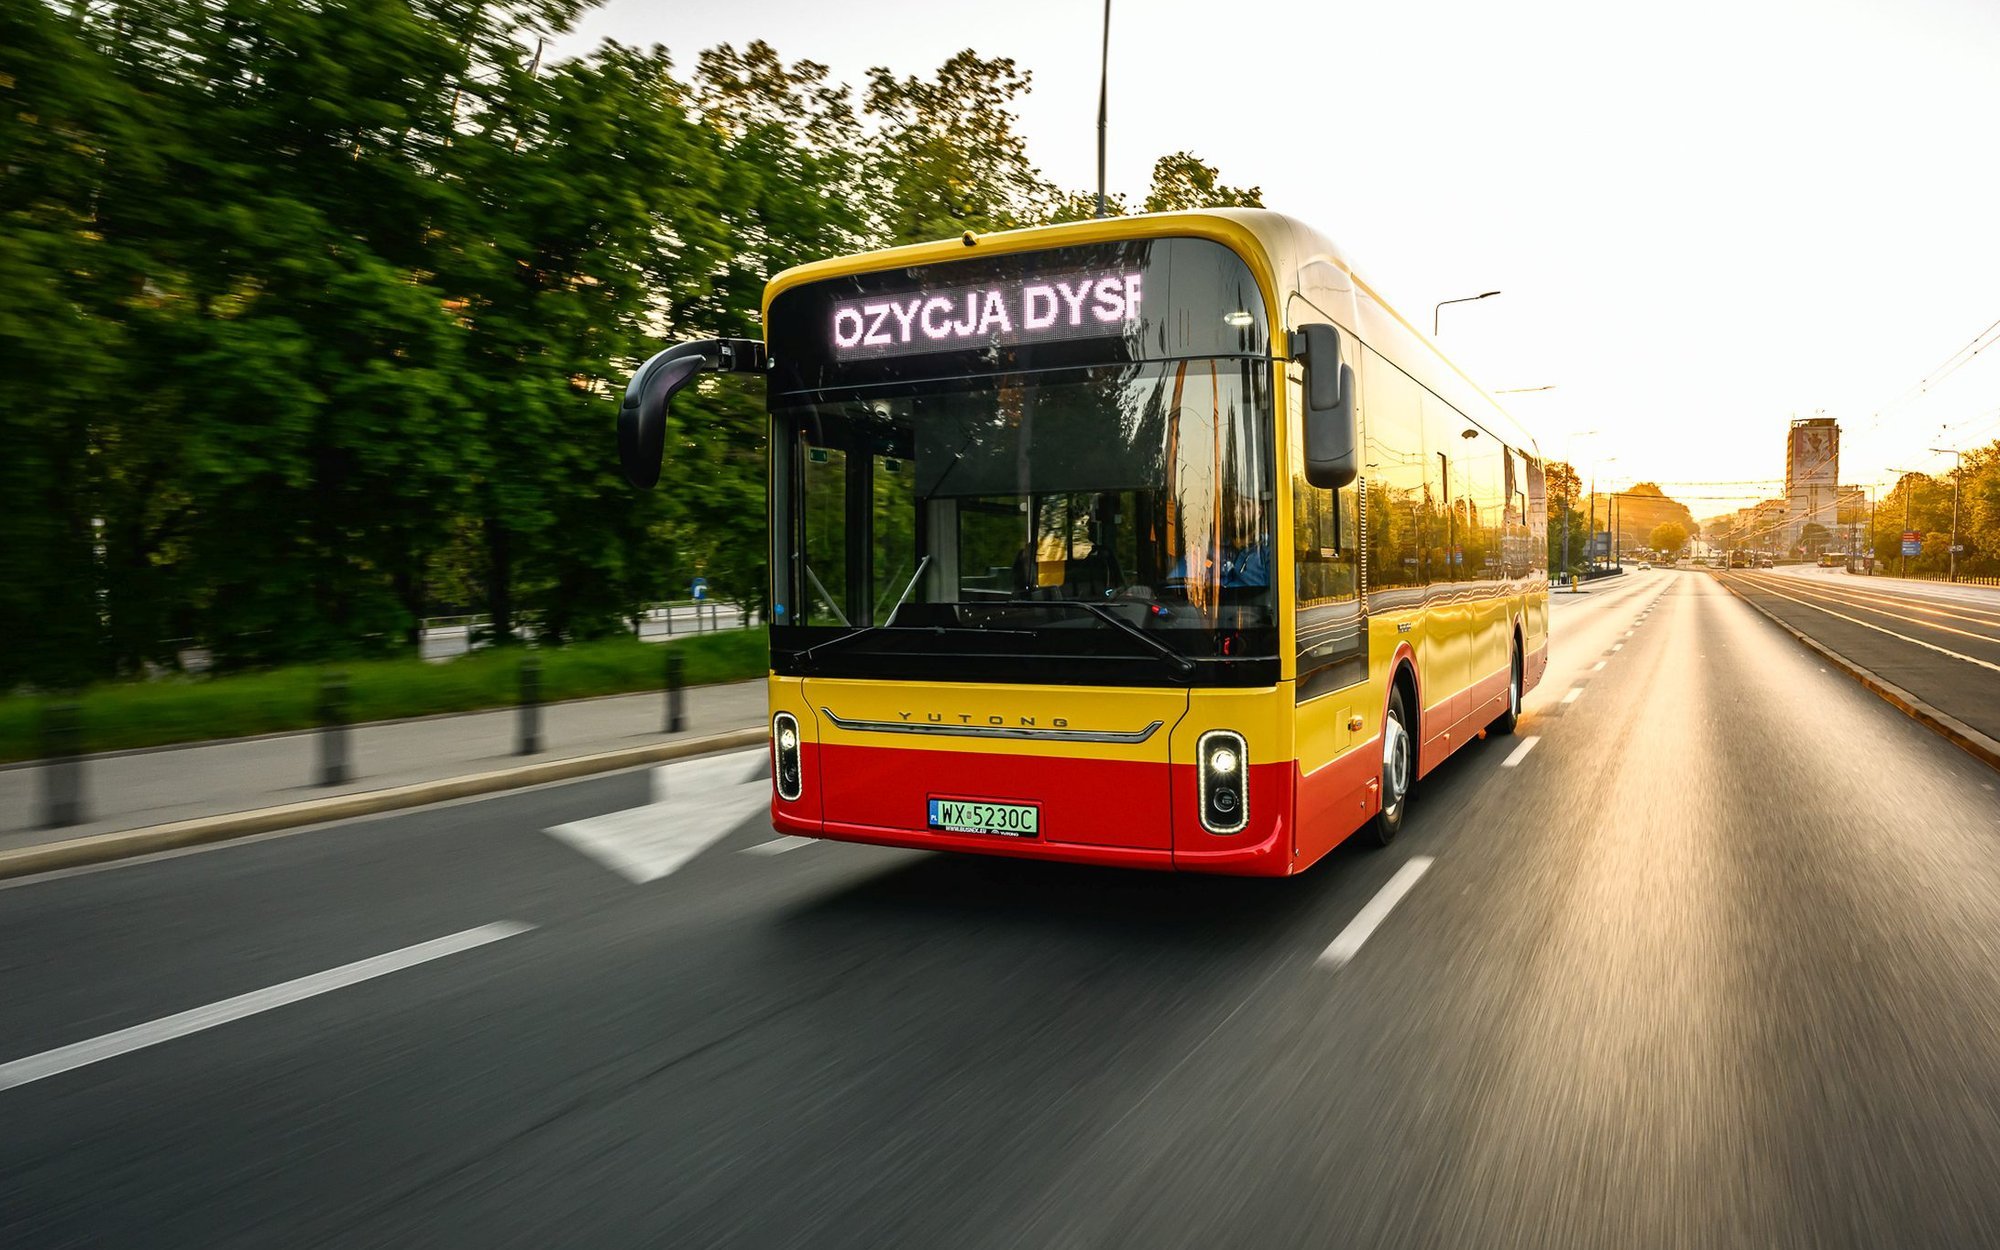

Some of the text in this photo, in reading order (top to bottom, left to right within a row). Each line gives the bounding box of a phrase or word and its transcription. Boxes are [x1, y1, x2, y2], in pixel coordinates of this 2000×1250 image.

[834, 290, 1012, 348] OZYCJA
[899, 712, 1068, 727] YUTONG
[942, 803, 1032, 829] WX 5230C
